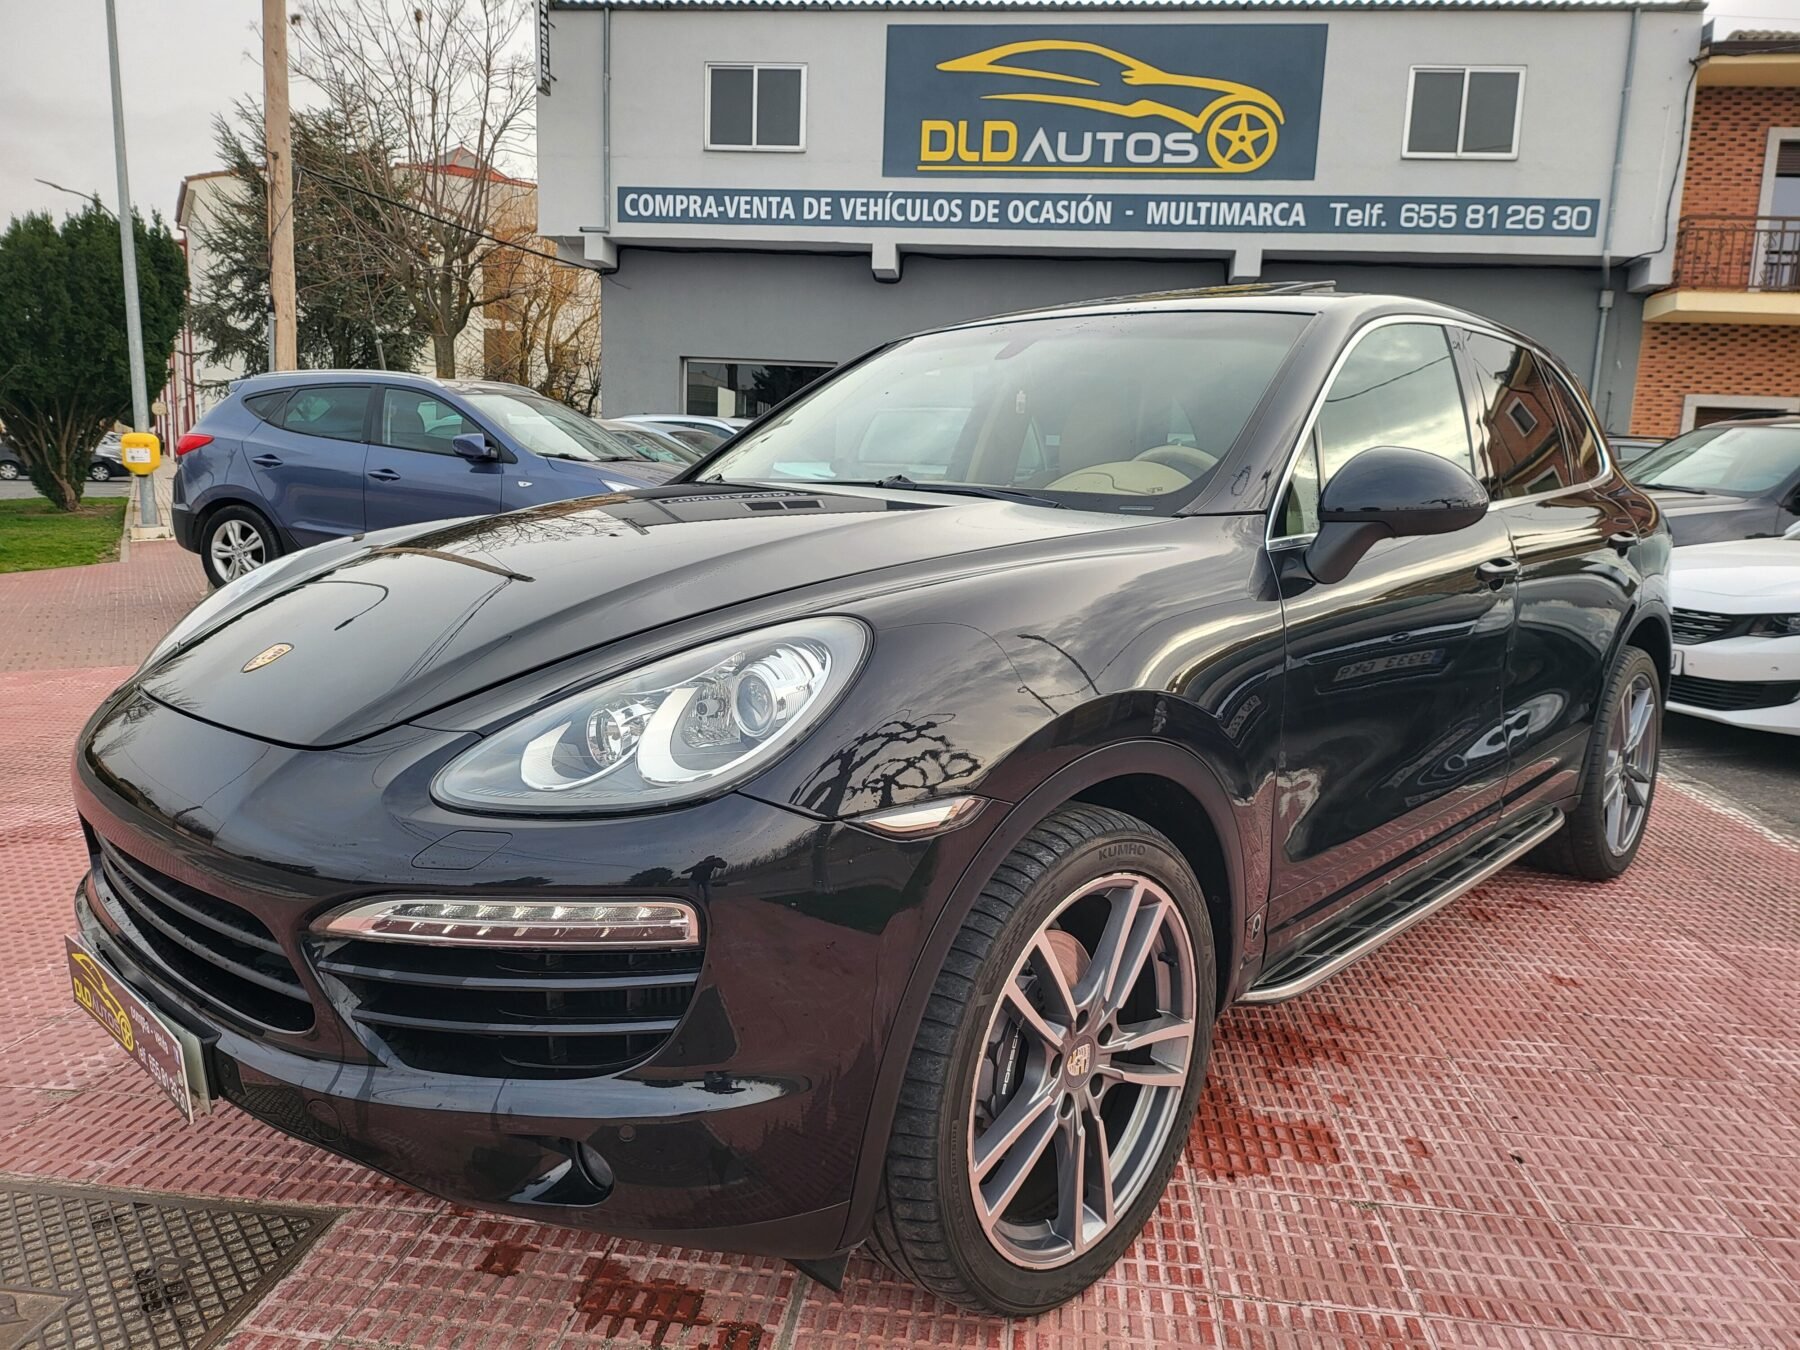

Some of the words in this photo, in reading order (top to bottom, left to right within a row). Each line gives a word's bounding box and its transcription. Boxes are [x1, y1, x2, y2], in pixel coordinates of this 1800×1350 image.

[920, 119, 1019, 163] DLD
[1022, 127, 1199, 163] AUTOS
[624, 193, 796, 219] COMPRA-VENTA
[803, 197, 832, 220] DE
[839, 191, 963, 222] VEHÍCULOS
[969, 199, 1000, 223] DE
[1007, 194, 1112, 224] OCASIÓN
[1146, 201, 1306, 227] MULTIMARCA
[1329, 203, 1386, 227] Telf.
[1400, 203, 1457, 228] 655
[1552, 205, 1592, 231] 30
[1098, 843, 1146, 861] KUMHO
[73, 977, 92, 1008] DLD
[92, 995, 122, 1036] AUTOS
